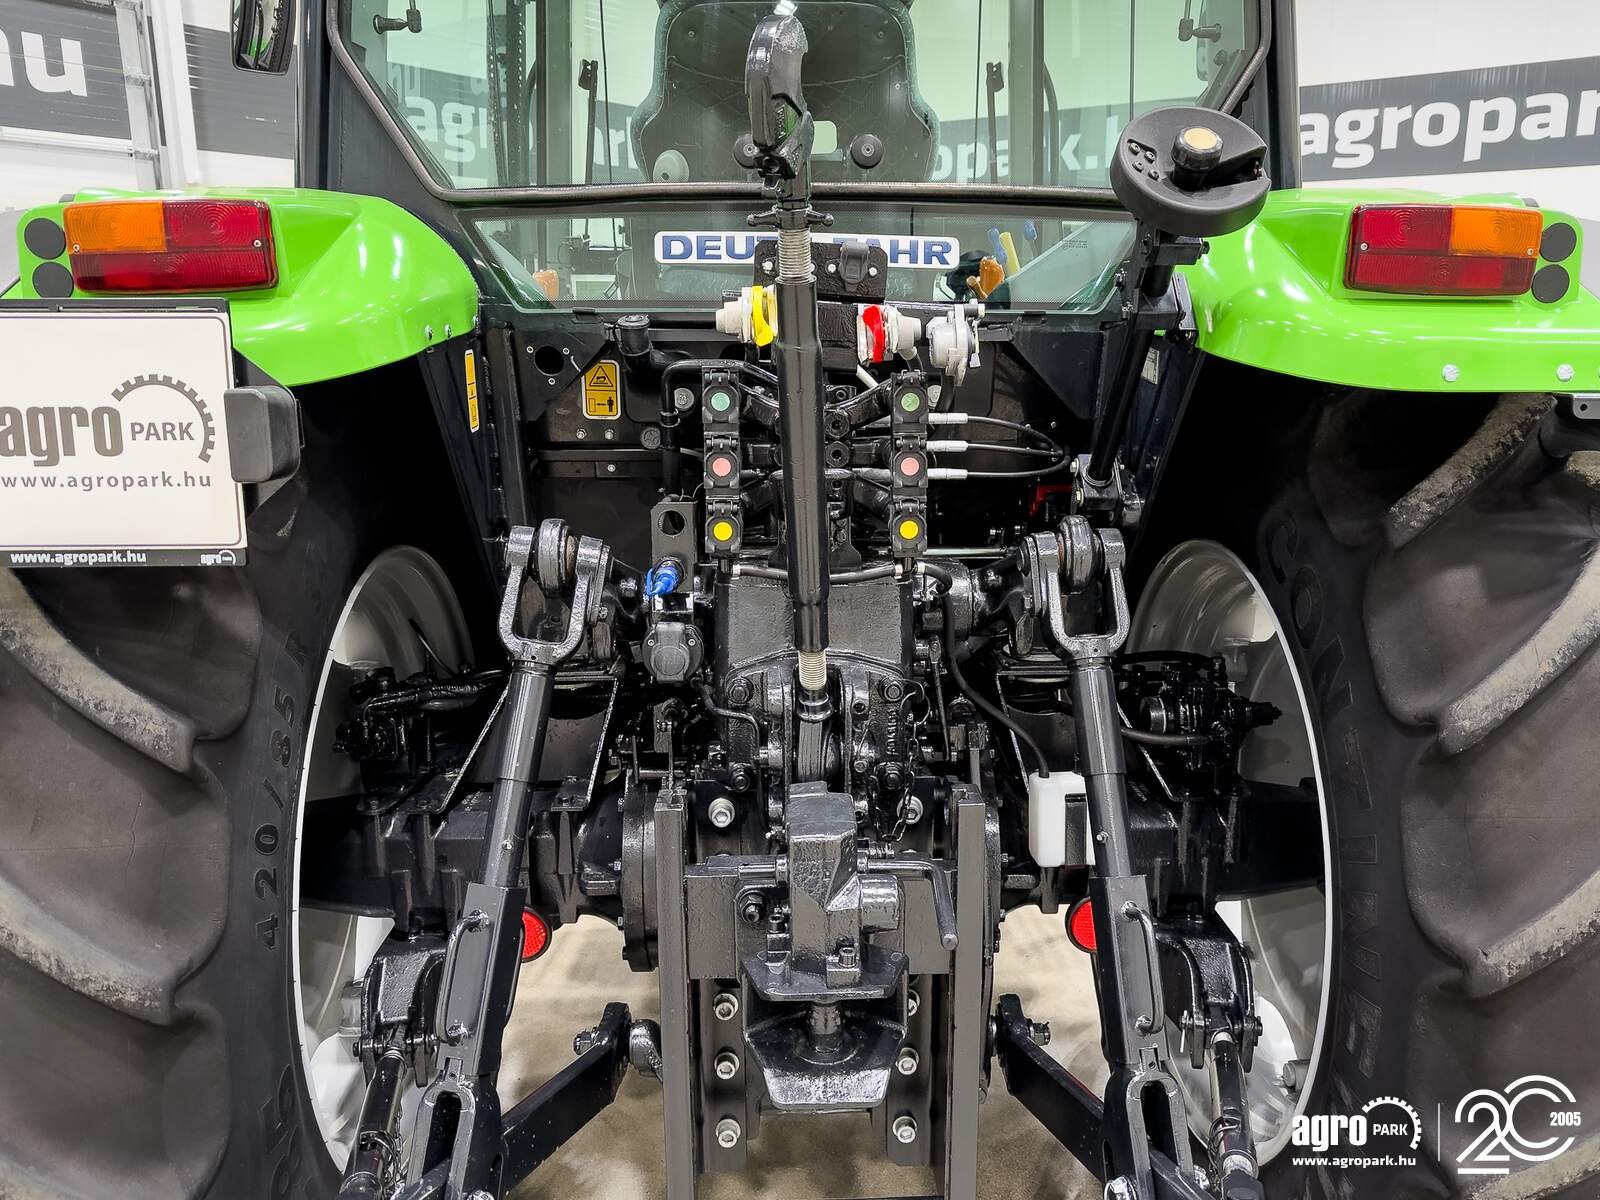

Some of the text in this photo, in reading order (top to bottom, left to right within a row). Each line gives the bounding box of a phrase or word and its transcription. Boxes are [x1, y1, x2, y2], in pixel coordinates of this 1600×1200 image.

[0, 28, 88, 97] u
[0, 406, 194, 467] agro PARK
[1, 471, 211, 492] www.agropark.hu
[10, 550, 147, 566] www.agropark.hu
